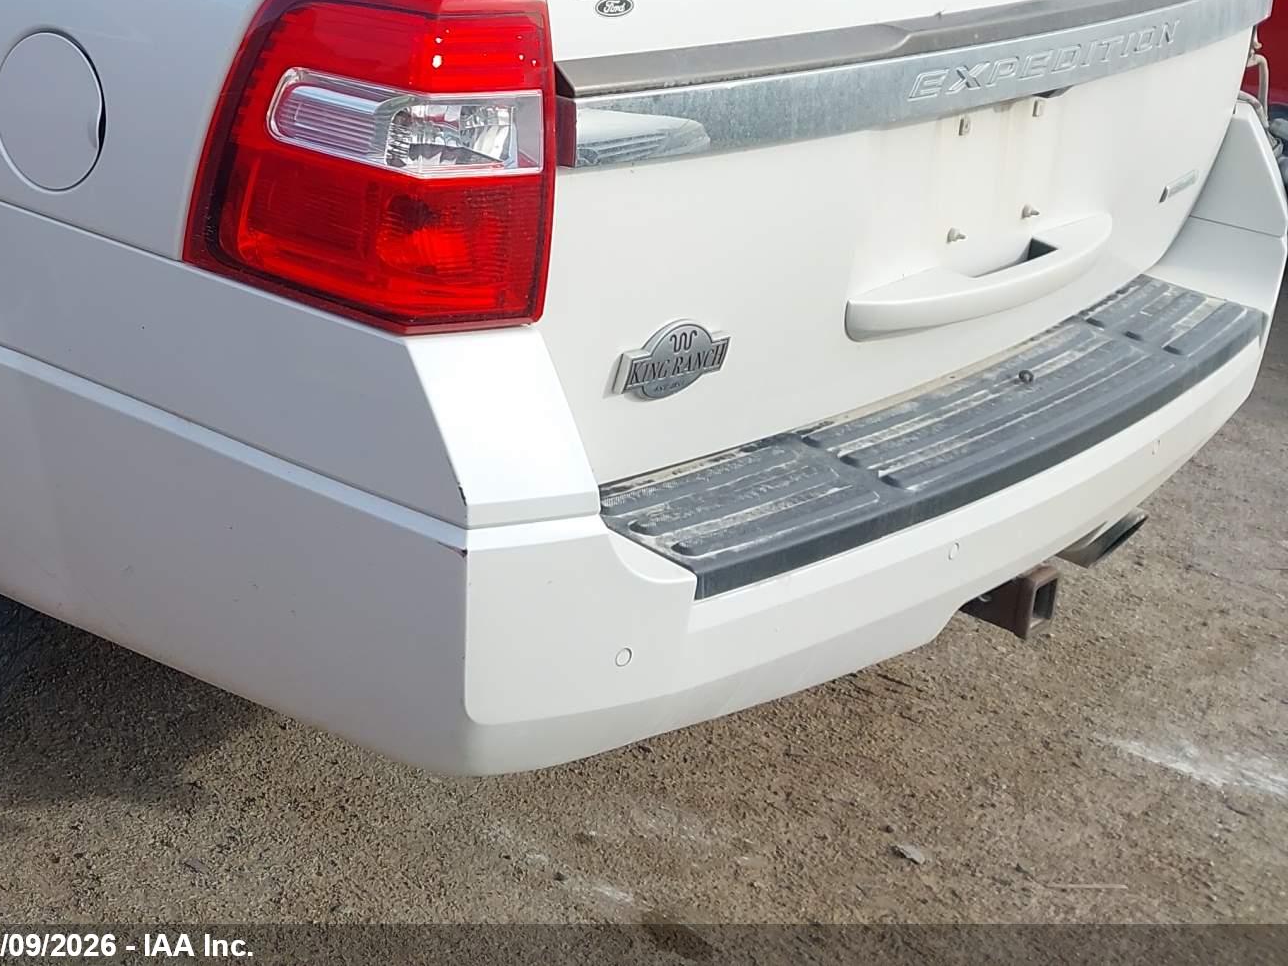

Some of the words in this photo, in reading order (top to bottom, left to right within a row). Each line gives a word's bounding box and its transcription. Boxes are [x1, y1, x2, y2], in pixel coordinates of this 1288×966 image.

[907, 19, 1181, 101] EXPEDITION
[629, 359, 670, 385] KING
[671, 343, 726, 375] RANCH
